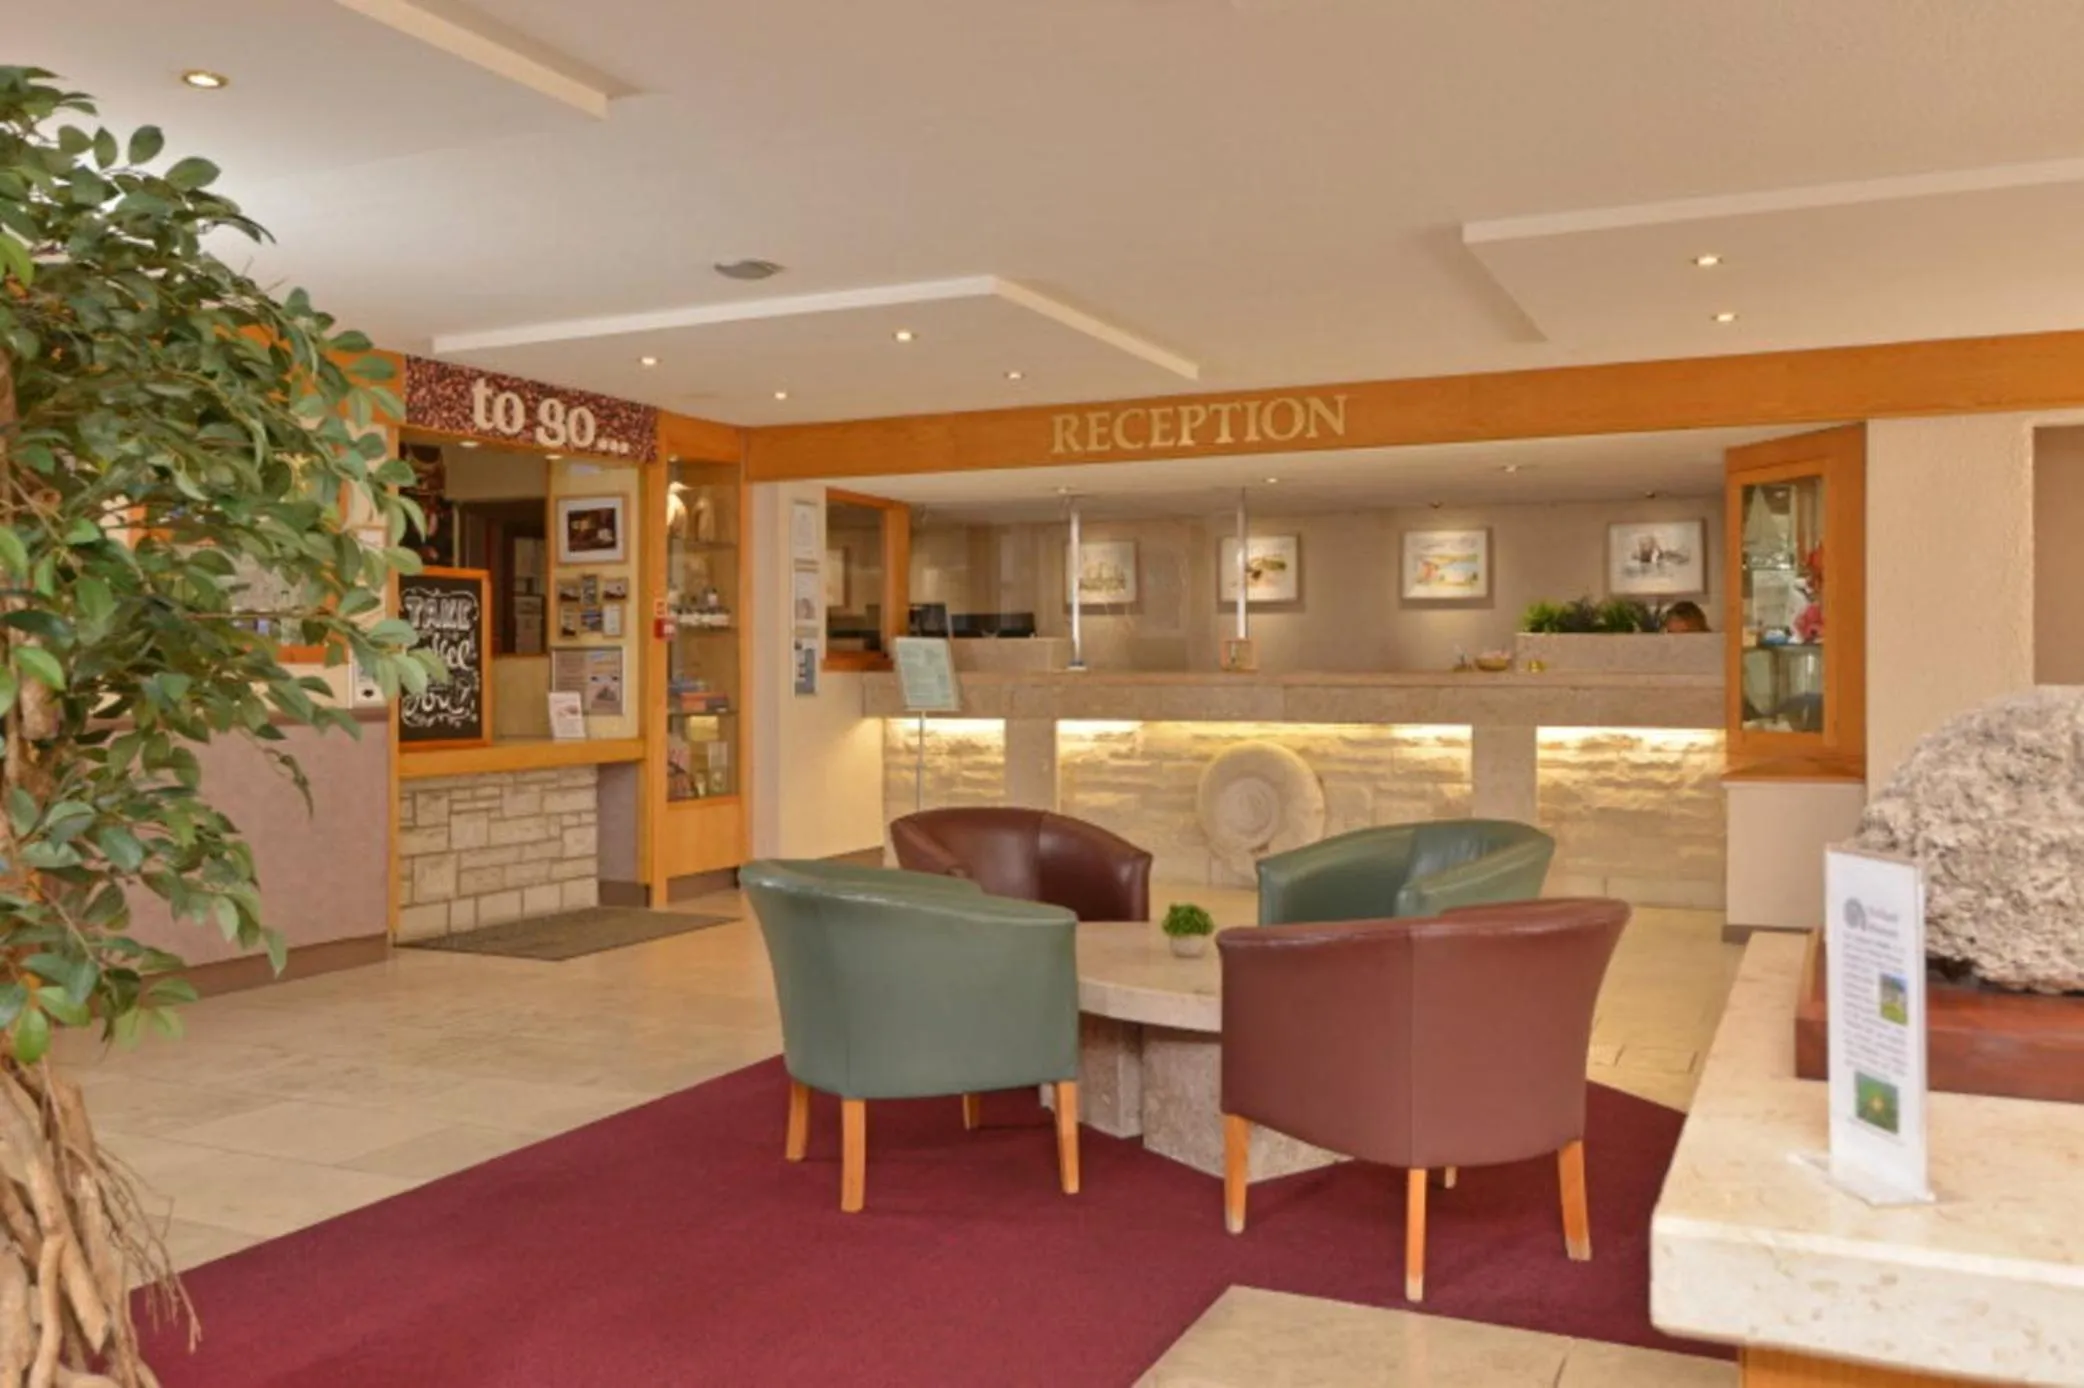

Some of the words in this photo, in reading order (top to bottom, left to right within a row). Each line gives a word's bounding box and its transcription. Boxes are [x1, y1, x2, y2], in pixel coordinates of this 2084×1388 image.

[472, 378, 526, 435] to
[1050, 395, 1348, 454] RECEPTION
[405, 595, 473, 631] TAKE
